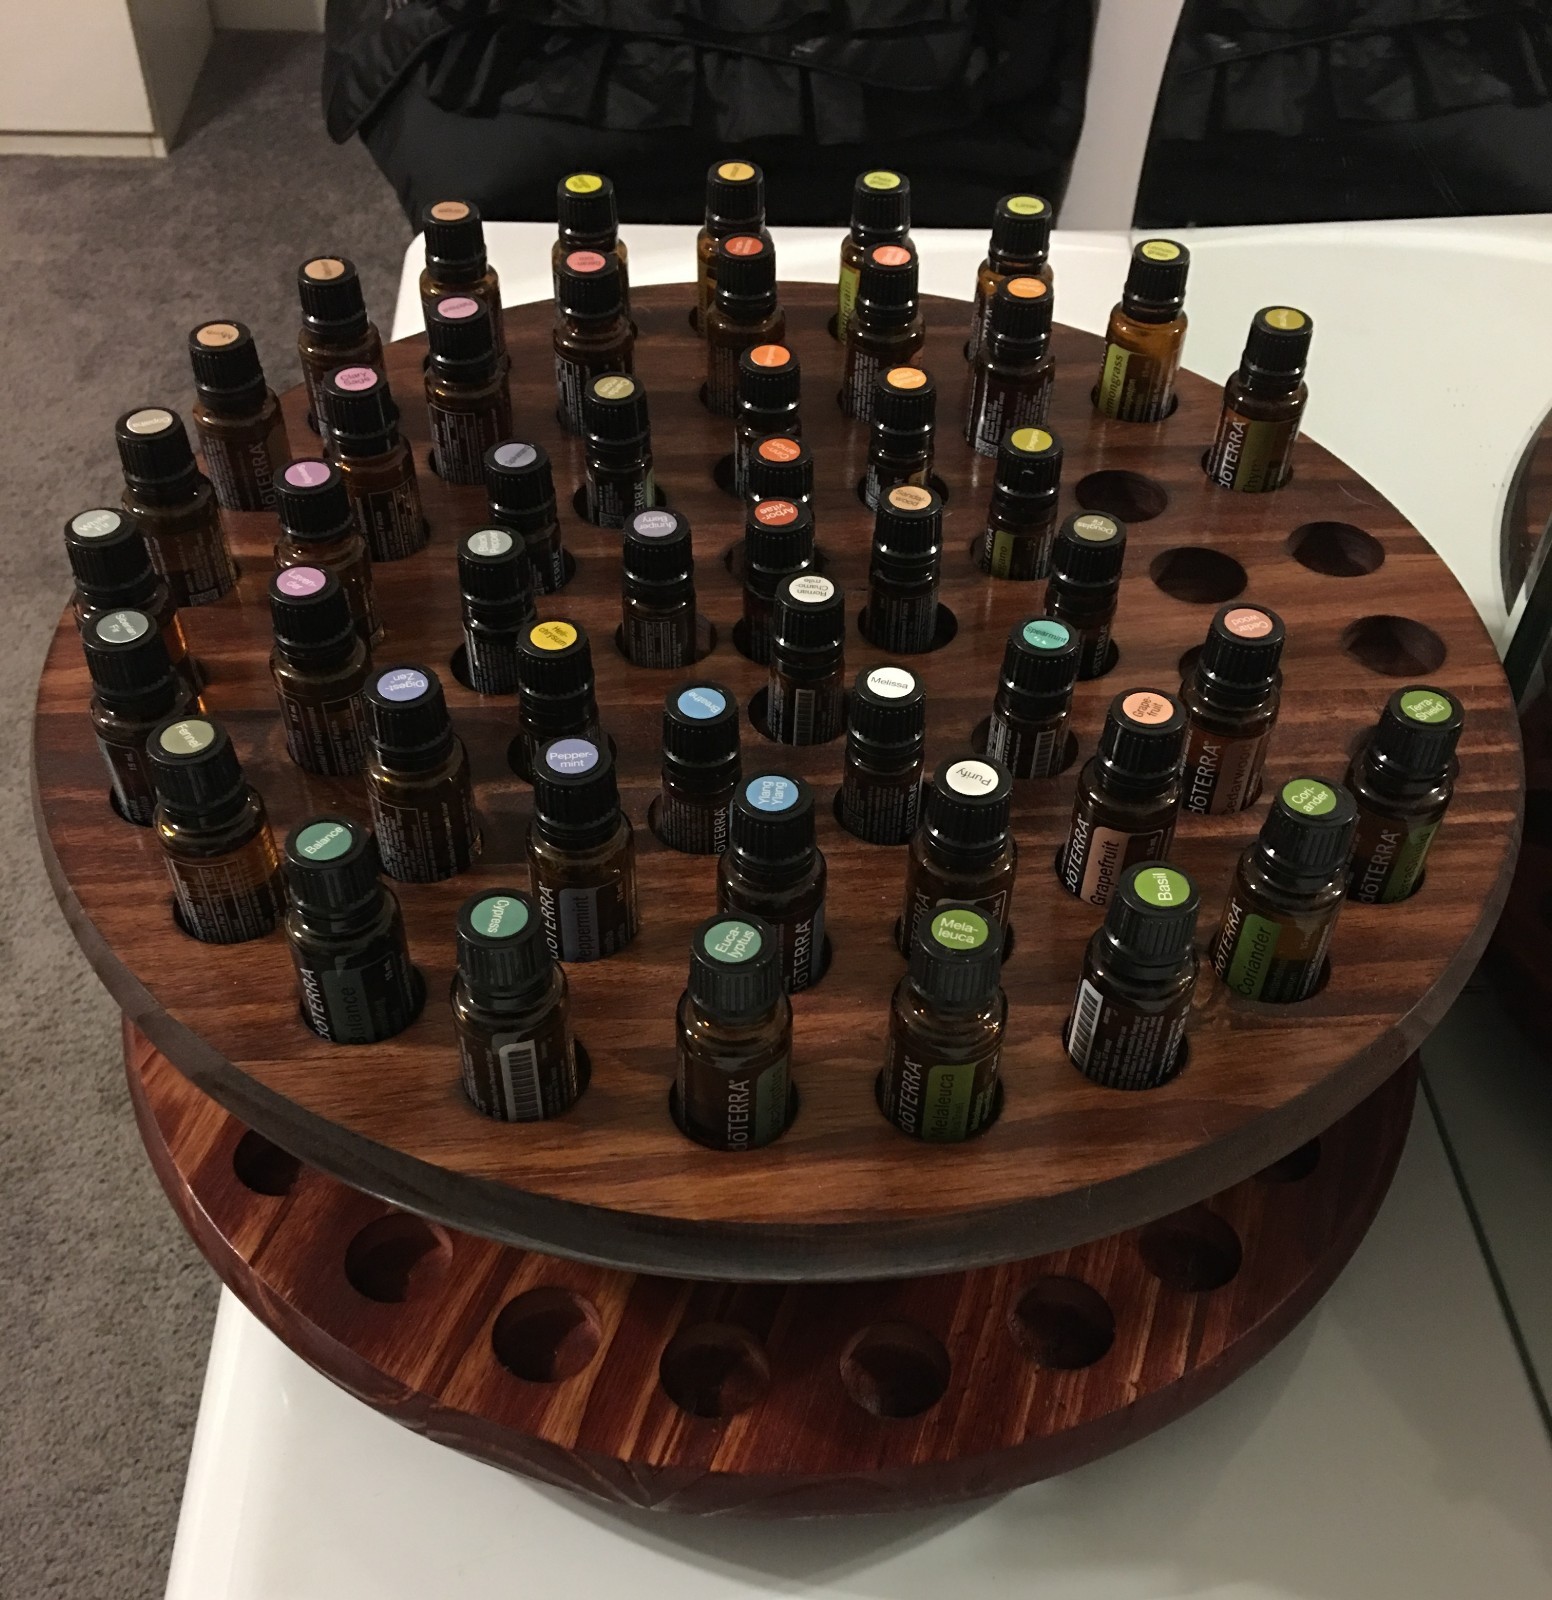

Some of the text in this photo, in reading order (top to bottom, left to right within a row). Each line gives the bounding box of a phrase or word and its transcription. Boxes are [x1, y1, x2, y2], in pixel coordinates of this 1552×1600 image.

[341, 372, 366, 380] Clary
[760, 504, 786, 514] vitae
[762, 508, 794, 521] Arbor-
[639, 521, 675, 530] Juniper
[1077, 522, 1114, 535] Douglas
[795, 583, 828, 591] Chamo-
[797, 589, 827, 597] Roman
[1231, 615, 1259, 625] wood
[1236, 621, 1269, 633] Cedar-
[538, 627, 567, 646] chrysum
[1026, 626, 1067, 643] Spearmint
[384, 679, 425, 692] Digest-
[871, 676, 909, 690] Melissa
[688, 692, 719, 713] Breathe
[1132, 696, 1152, 718] Grape-
[1148, 704, 1164, 717] fruit
[1406, 698, 1433, 713] Terra-
[176, 723, 203, 749] Fennel
[550, 752, 593, 761] Pepper-
[560, 760, 584, 768] mint
[956, 768, 992, 787] Purify
[758, 781, 774, 805] Ylang
[771, 781, 787, 806] Ylang
[1292, 786, 1315, 804] Cori-
[1303, 790, 1329, 812] ander
[304, 826, 344, 855] Balance
[1090, 841, 1119, 906] Grapefruit
[1152, 873, 1173, 901] Basil
[487, 899, 509, 933] Cypress
[940, 918, 979, 933] Mela-
[715, 926, 740, 953] Euca-
[727, 930, 755, 958] lyptus
[938, 928, 975, 944] leuca
[1237, 926, 1272, 996] Coriander
[929, 1074, 955, 1138] Melaleuca
